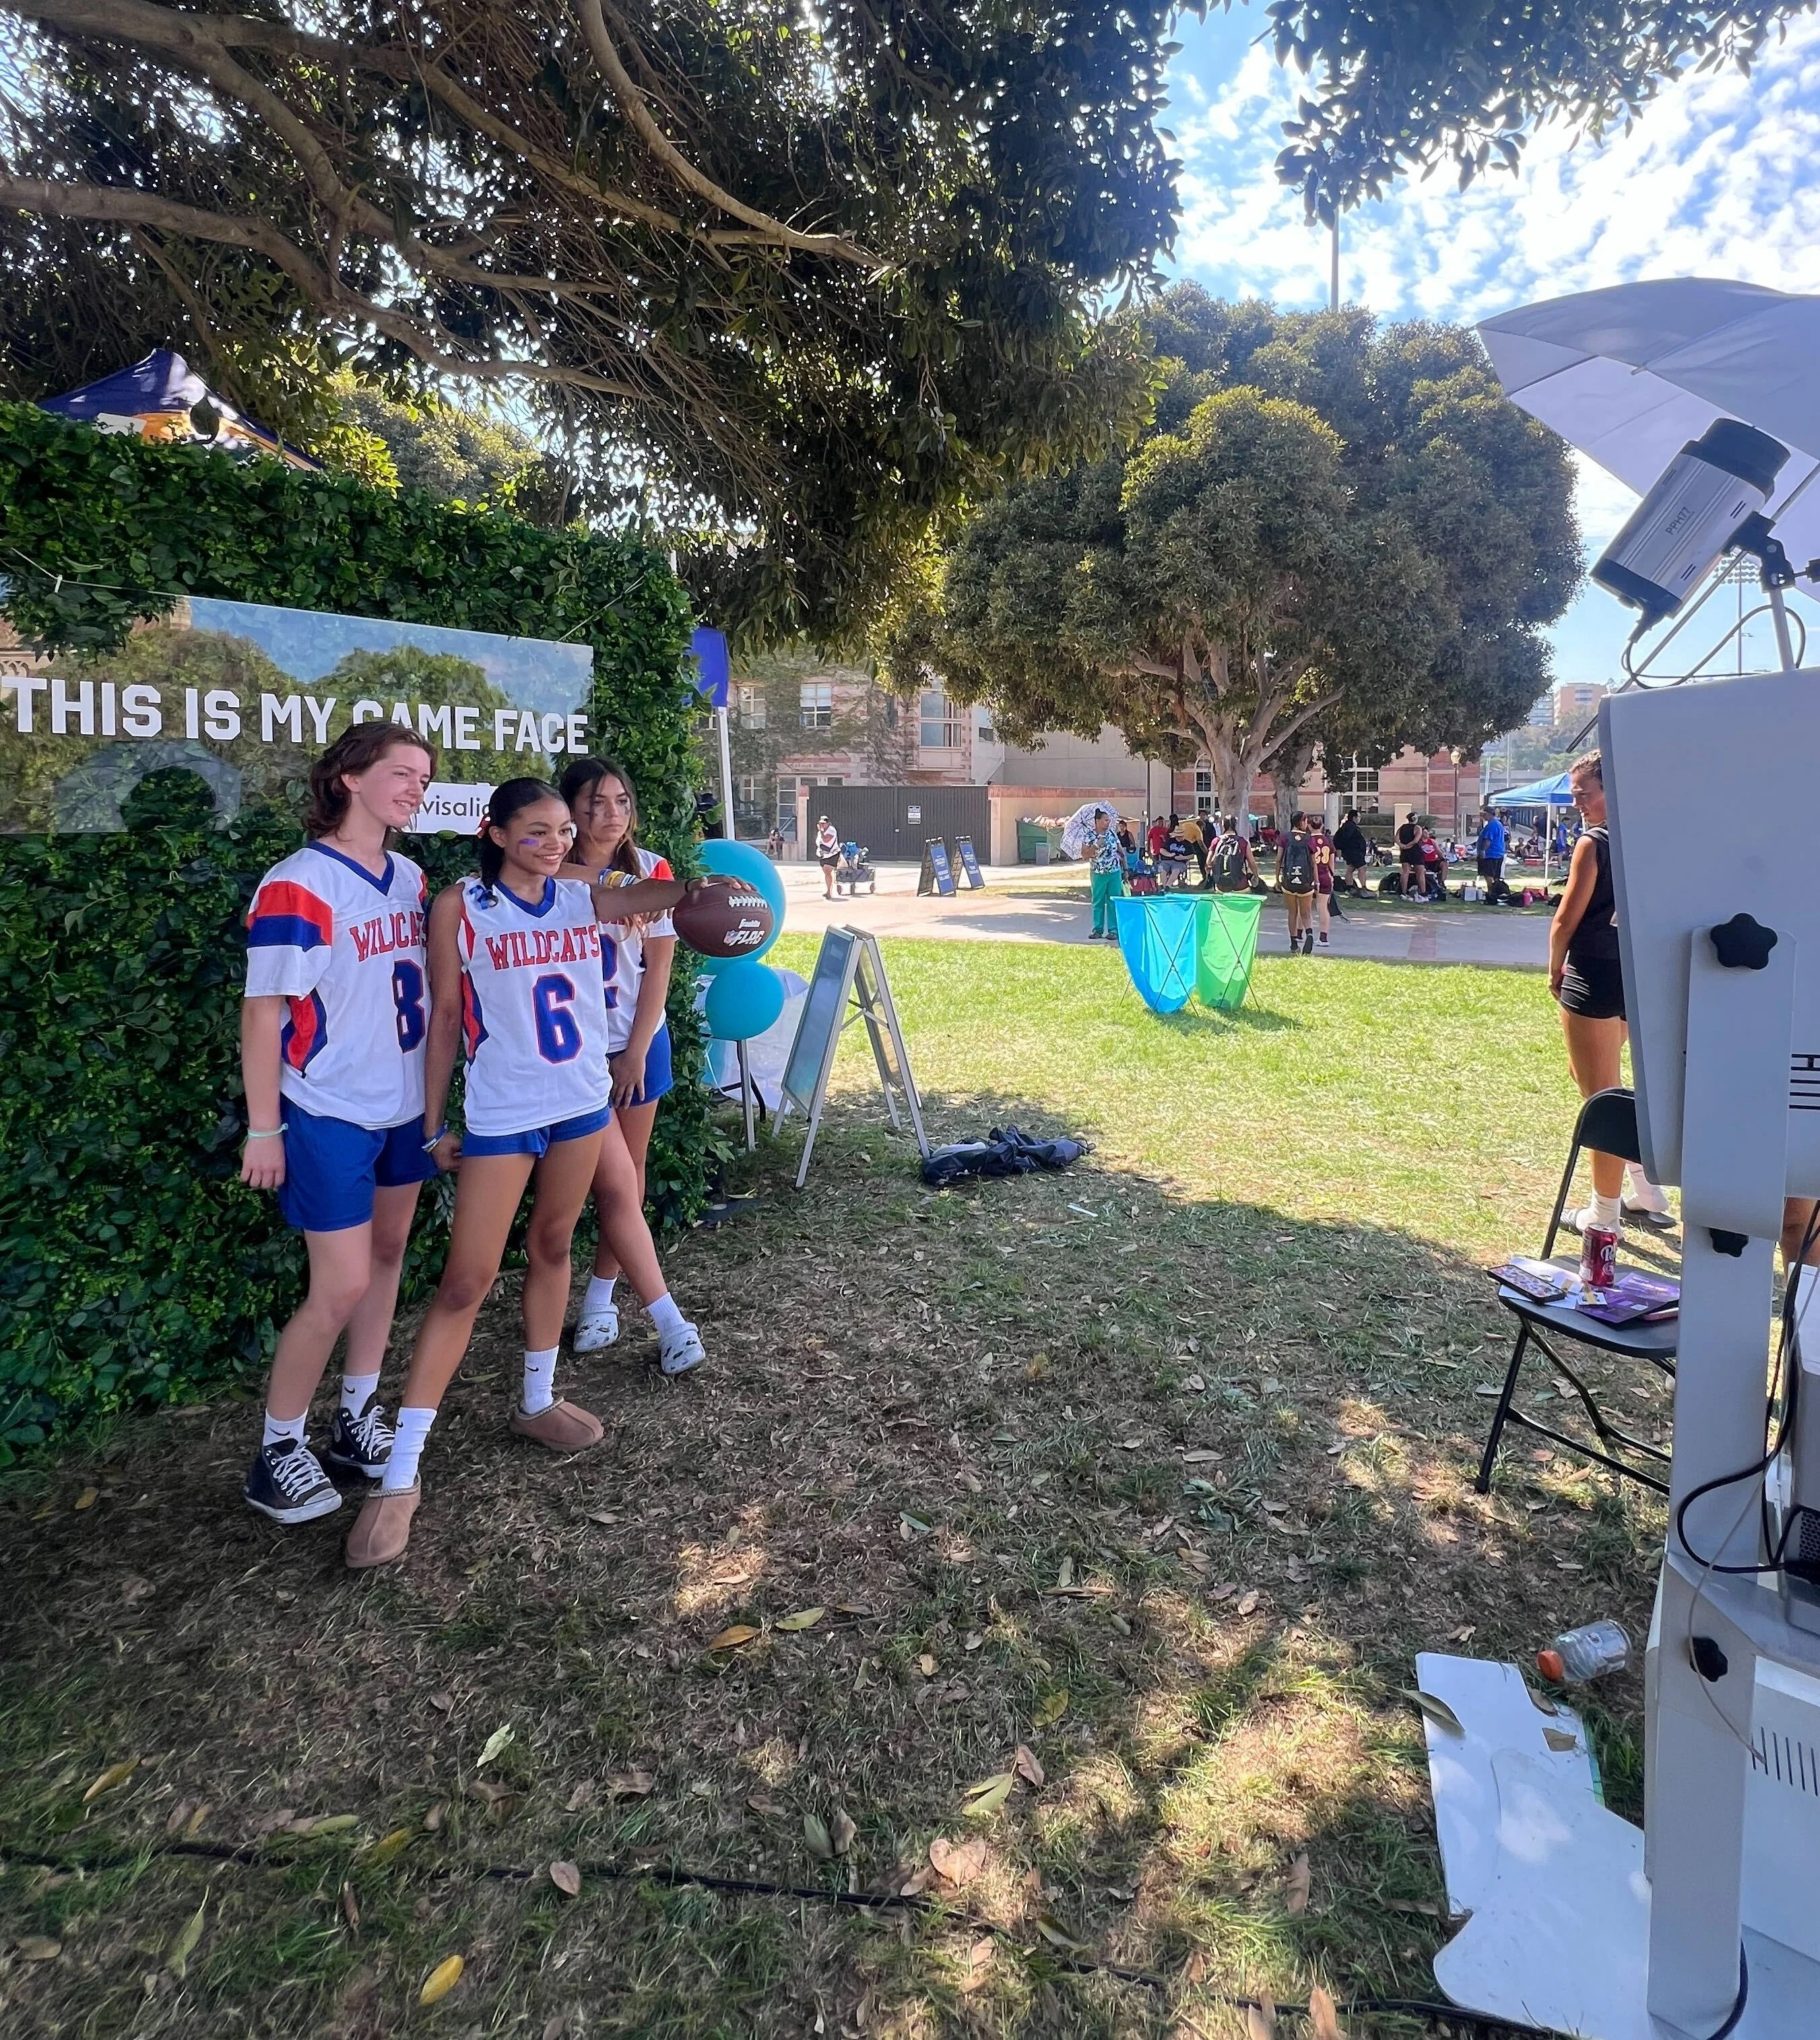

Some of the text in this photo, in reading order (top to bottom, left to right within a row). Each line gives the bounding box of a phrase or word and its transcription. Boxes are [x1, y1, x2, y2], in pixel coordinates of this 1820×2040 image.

[1, 676, 162, 737] THIS
[185, 688, 241, 740] IS
[261, 693, 336, 744] MY
[494, 709, 589, 754] FACE
[418, 795, 490, 817] visali
[485, 924, 600, 970] WILDCATS
[532, 973, 583, 1064] 6
